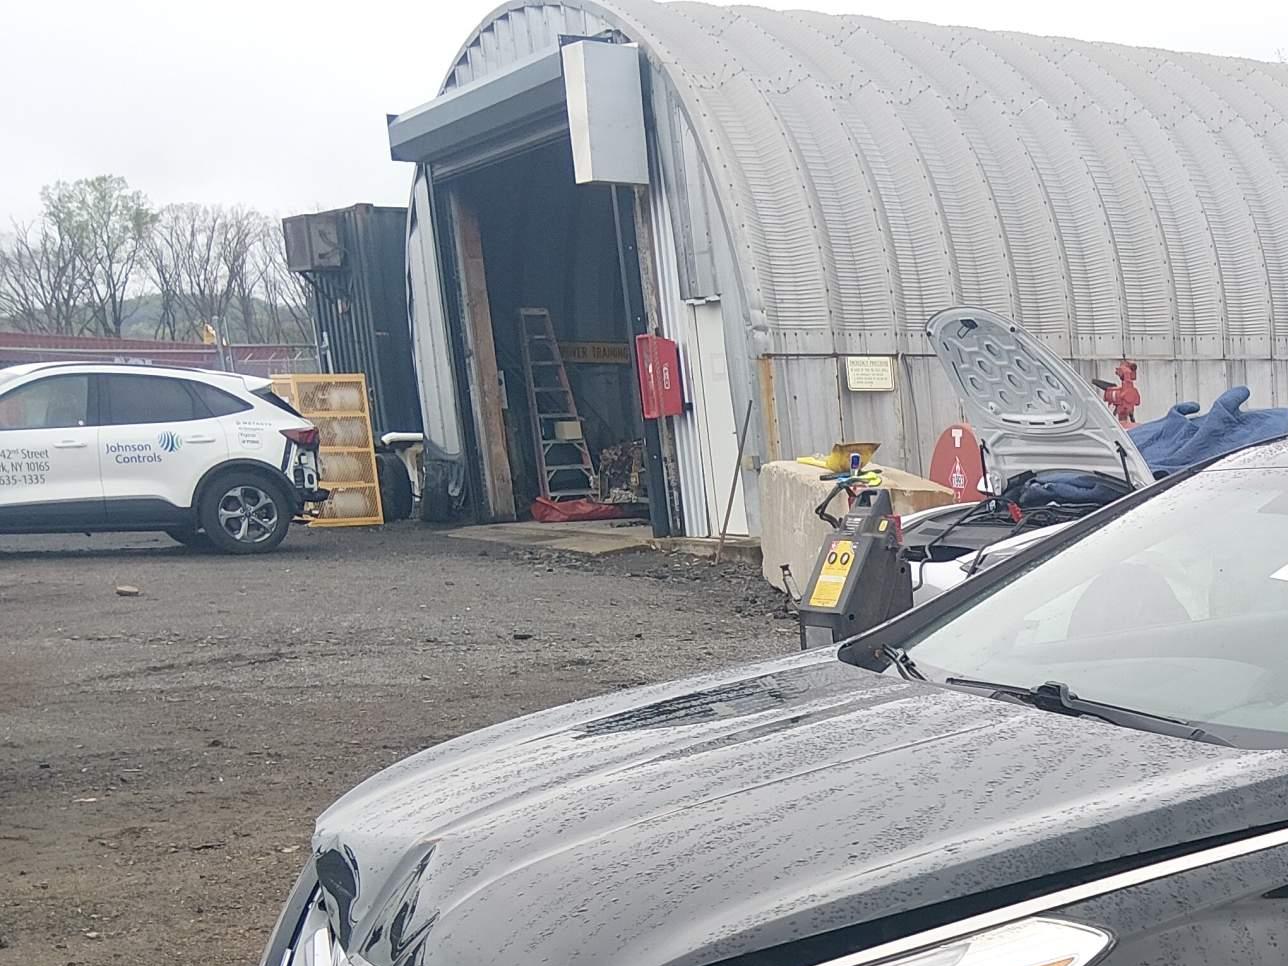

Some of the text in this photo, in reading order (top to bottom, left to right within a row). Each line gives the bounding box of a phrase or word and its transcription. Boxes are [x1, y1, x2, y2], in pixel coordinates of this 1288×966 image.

[106, 443, 152, 454] Johnson
[21, 449, 49, 459] Street
[115, 452, 162, 464] Controls
[11, 461, 23, 471] NY
[26, 461, 50, 471] 10165
